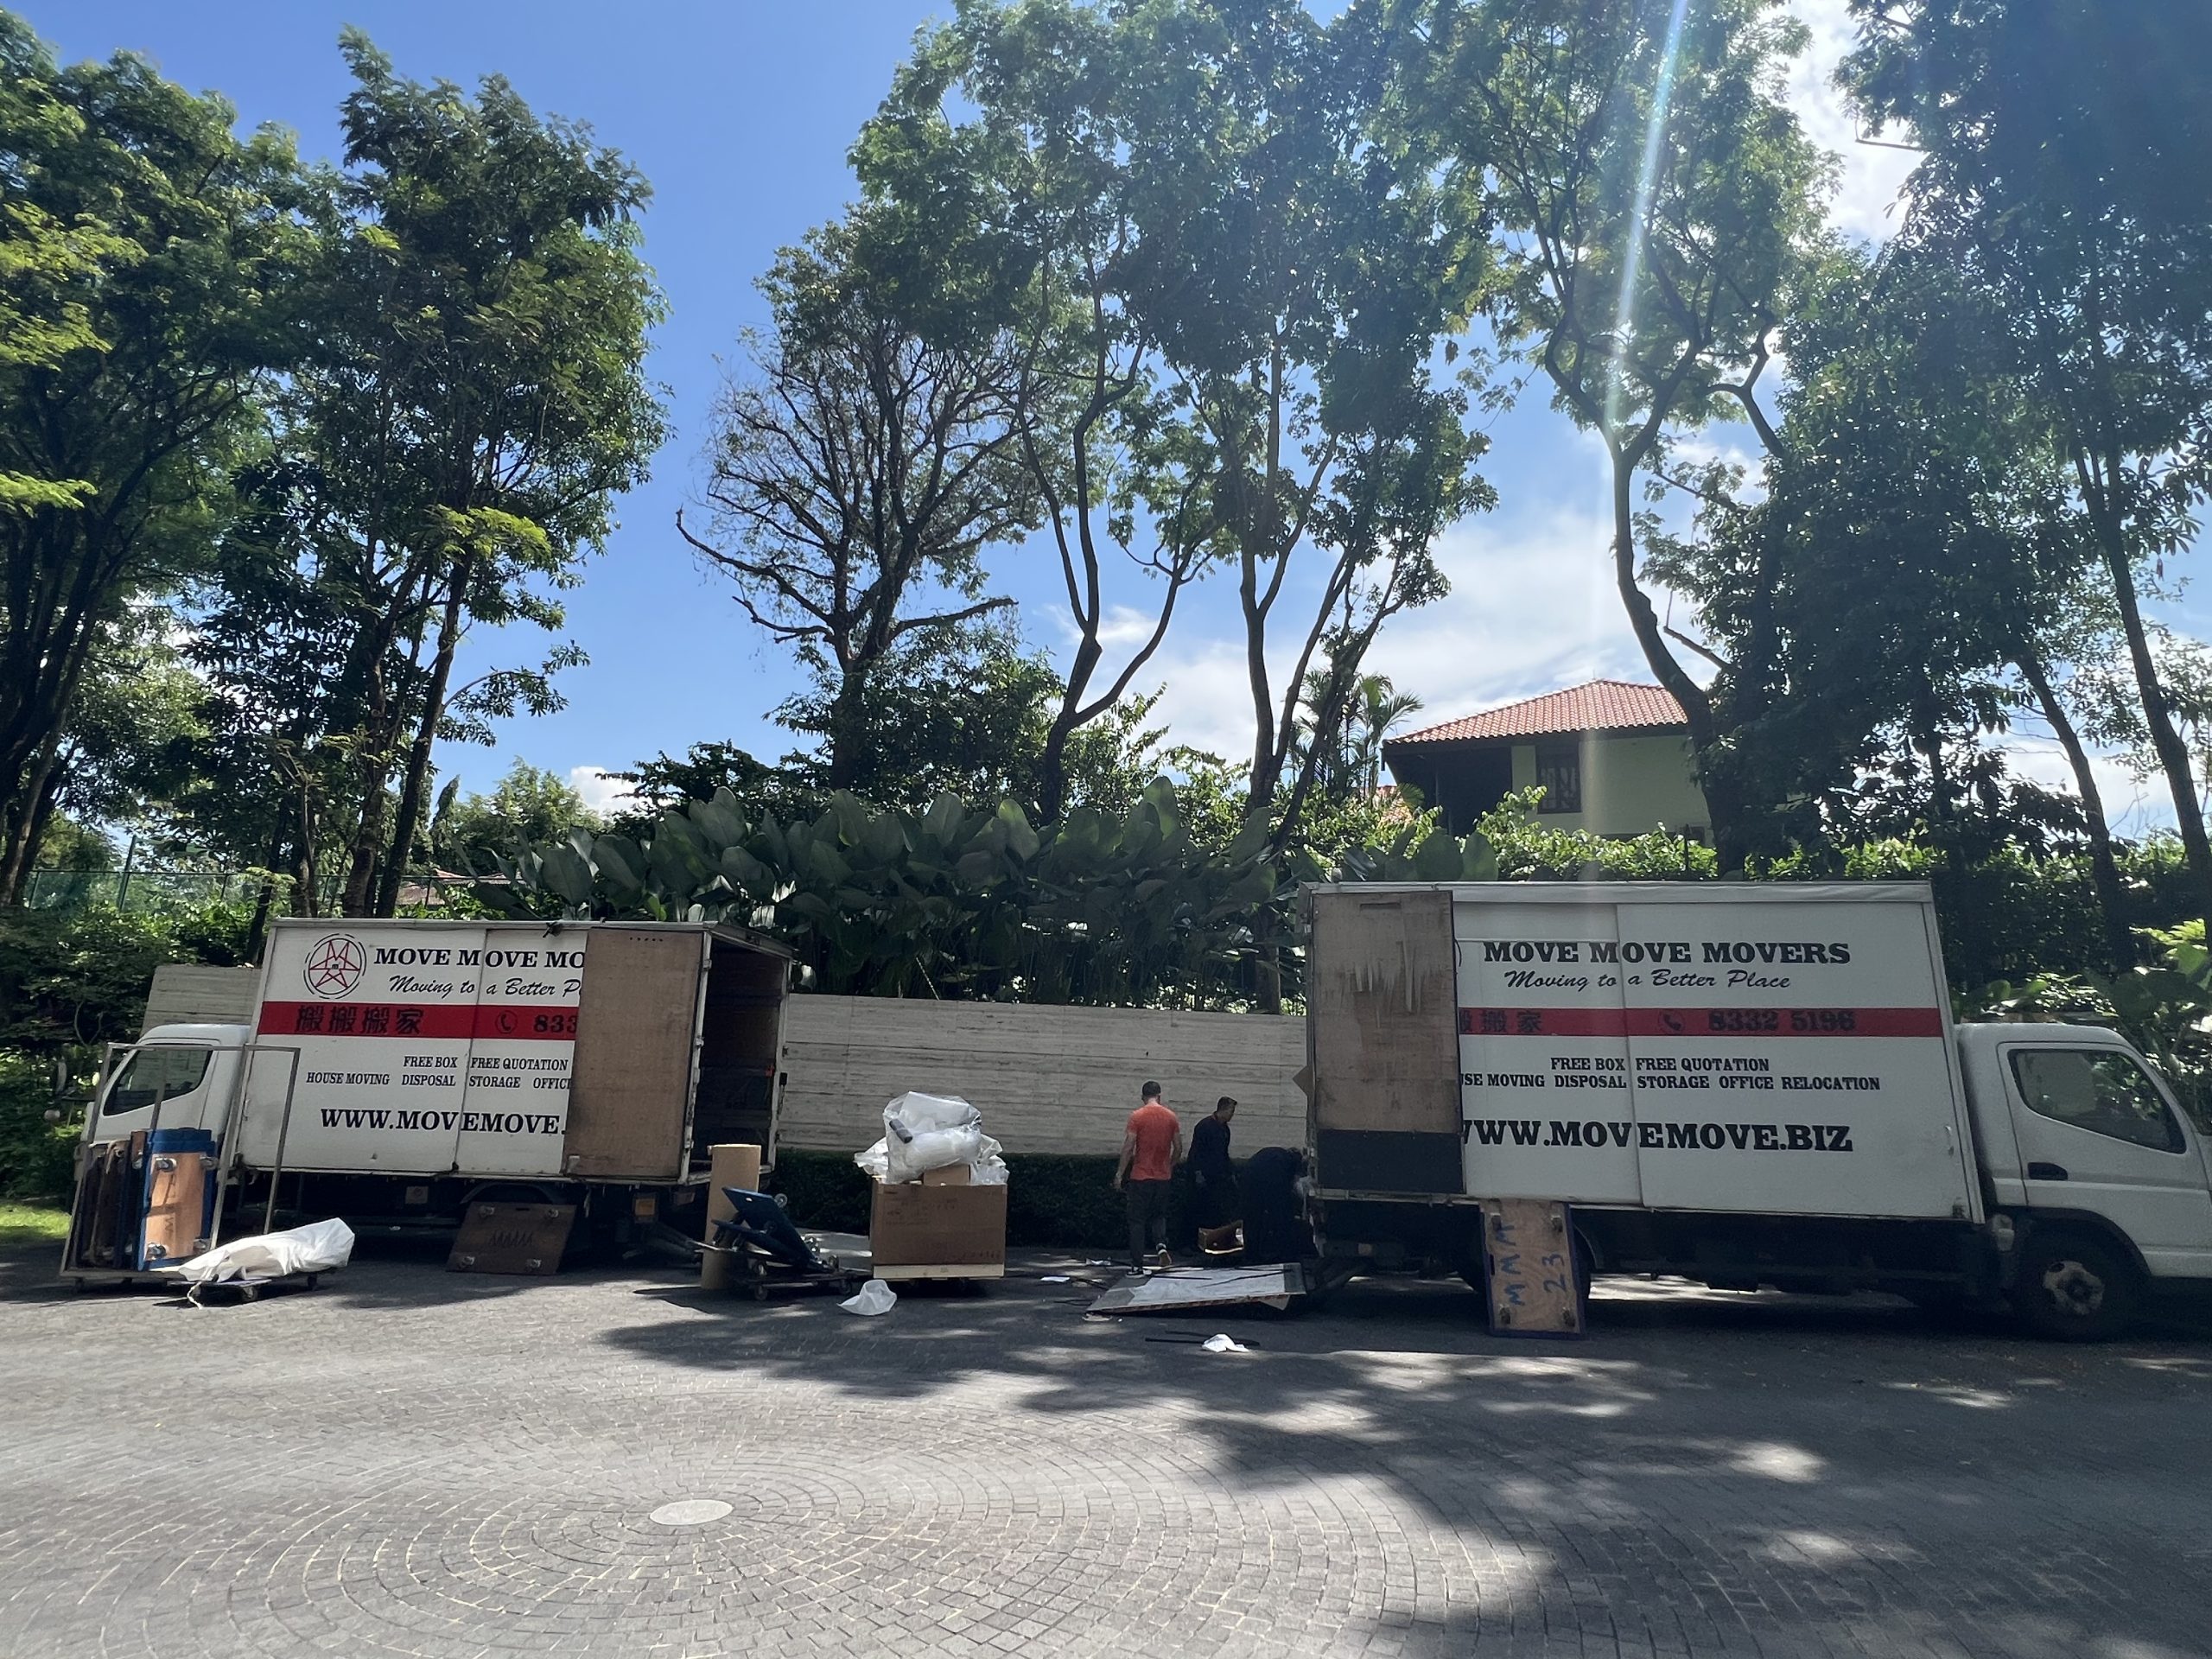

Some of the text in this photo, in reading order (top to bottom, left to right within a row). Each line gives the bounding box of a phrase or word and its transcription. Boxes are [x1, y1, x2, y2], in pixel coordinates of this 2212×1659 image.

[373, 948, 450, 966] MOVE
[456, 949, 538, 968] MOVE
[1483, 941, 1851, 963] MOVE MOVE MOVERS
[389, 975, 581, 999] Moving to a Better P
[1503, 969, 1792, 992] Moving to a Better Place
[1708, 1010, 1855, 1031] 8332 5196
[403, 1055, 569, 1071] FREE BOX FREE QUOTATION
[1550, 1057, 1770, 1072] FREE BOX FREE QUOTATION
[306, 1071, 345, 1084] HOUSE
[345, 1073, 391, 1085] MOVING
[401, 1074, 456, 1087] DISPOSAL
[468, 1075, 521, 1089] STORAGE
[1486, 1073, 1545, 1087] MOVING
[1554, 1075, 1627, 1089] DISPOSAL
[1637, 1075, 1711, 1089] STORAGE
[1719, 1075, 1775, 1090] OFFICE
[1780, 1076, 1881, 1090] RELOCATION
[1541, 1253, 1567, 1294] 23
